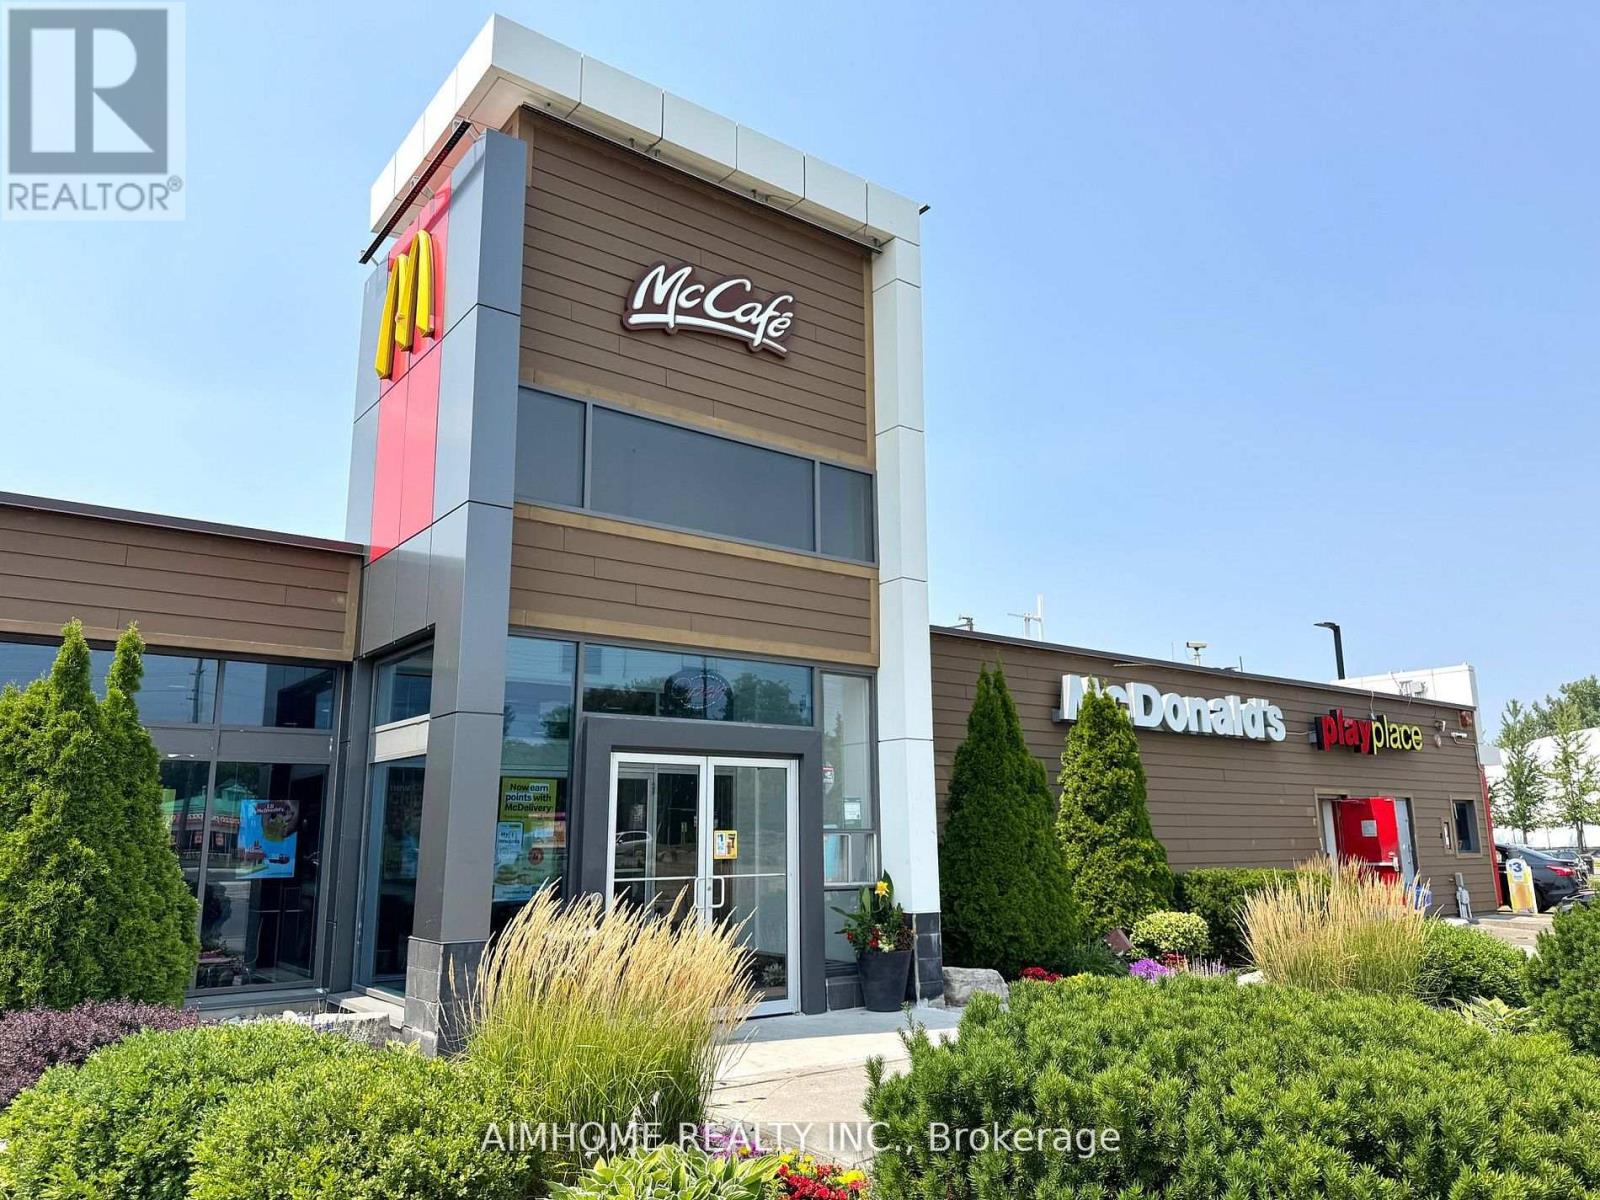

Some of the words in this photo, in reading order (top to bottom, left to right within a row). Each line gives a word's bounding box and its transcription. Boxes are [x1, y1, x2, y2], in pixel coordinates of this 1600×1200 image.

[630, 264, 795, 352] McCafé
[510, 783, 529, 791] Now
[505, 793, 531, 802] points
[504, 803, 551, 813] McDelivery
